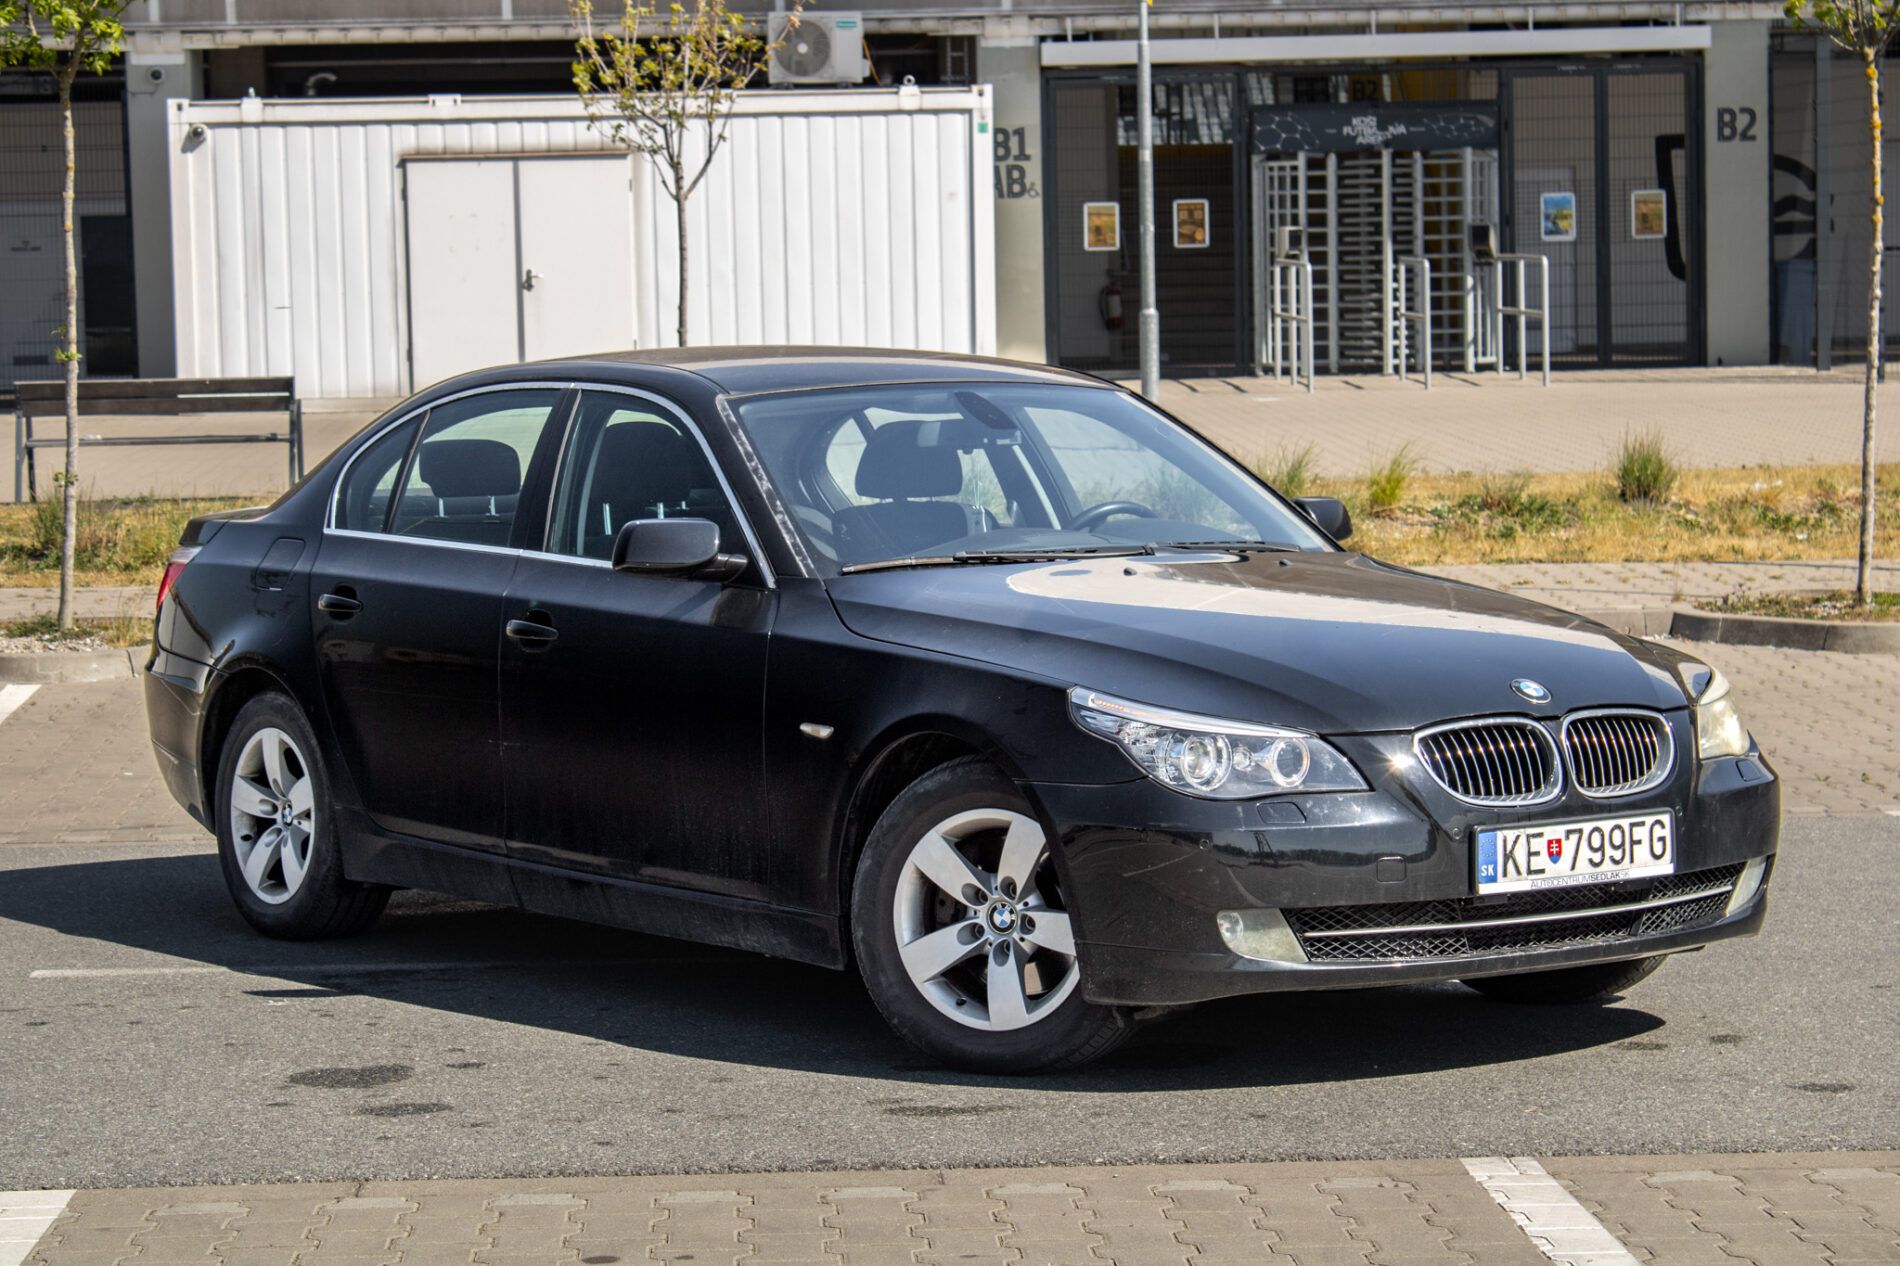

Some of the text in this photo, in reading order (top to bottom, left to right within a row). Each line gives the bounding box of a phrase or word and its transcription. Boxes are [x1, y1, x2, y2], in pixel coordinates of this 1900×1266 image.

[1717, 107, 1757, 142] B2
[993, 127, 1031, 161] B1
[1502, 819, 1667, 877] KE 799FG
[1481, 864, 1495, 877] SK
